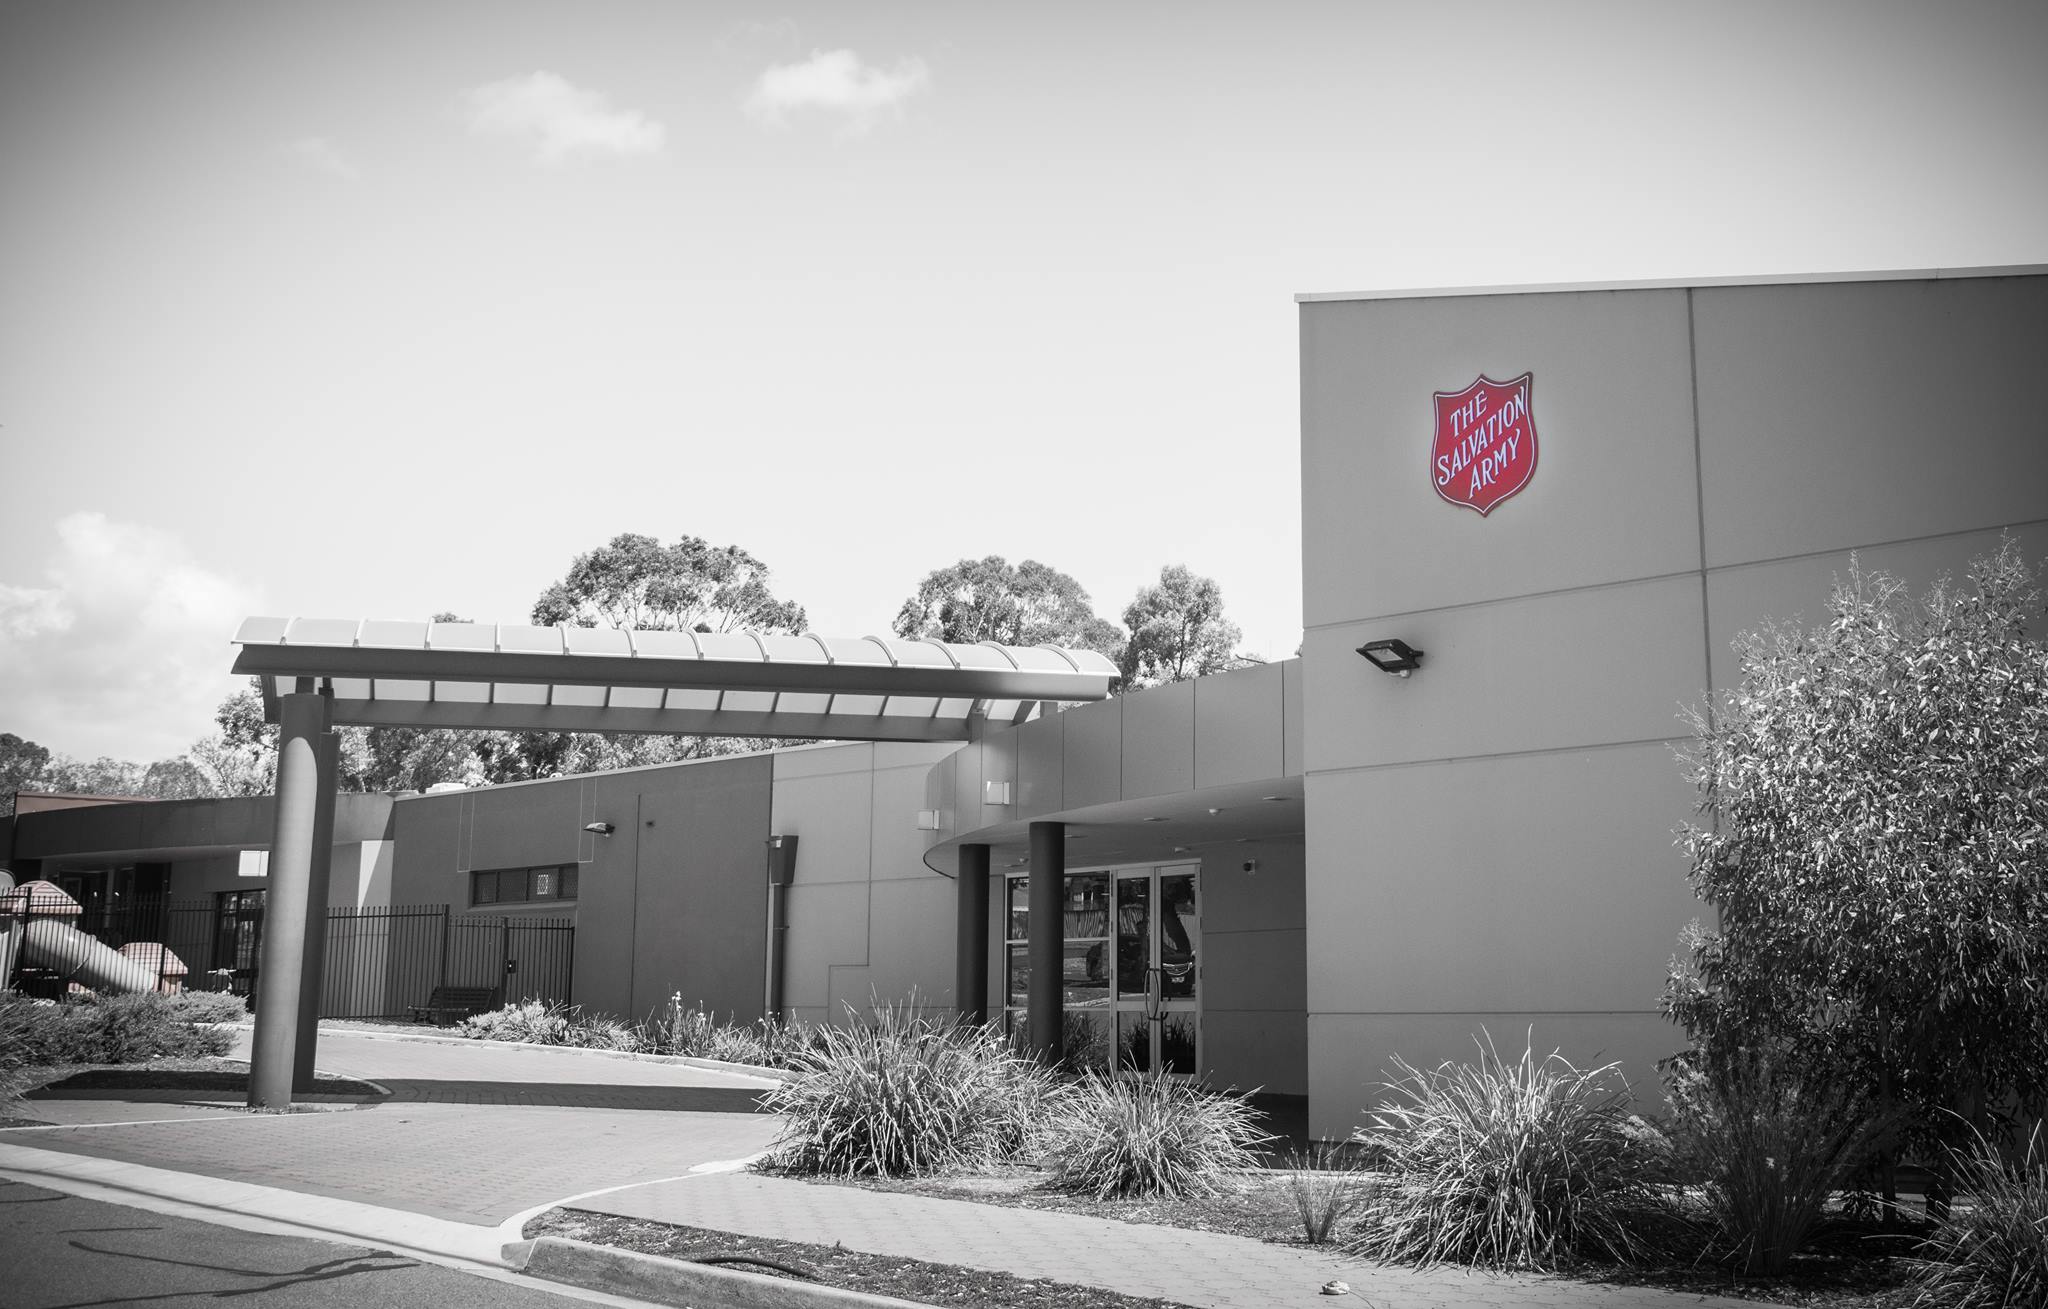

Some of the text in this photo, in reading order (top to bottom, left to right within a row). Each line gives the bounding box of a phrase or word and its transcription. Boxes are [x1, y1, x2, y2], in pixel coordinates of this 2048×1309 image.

[1437, 385, 1526, 486] SALVATION
[1450, 390, 1488, 437] THE
[1469, 428, 1521, 499] ARMY
